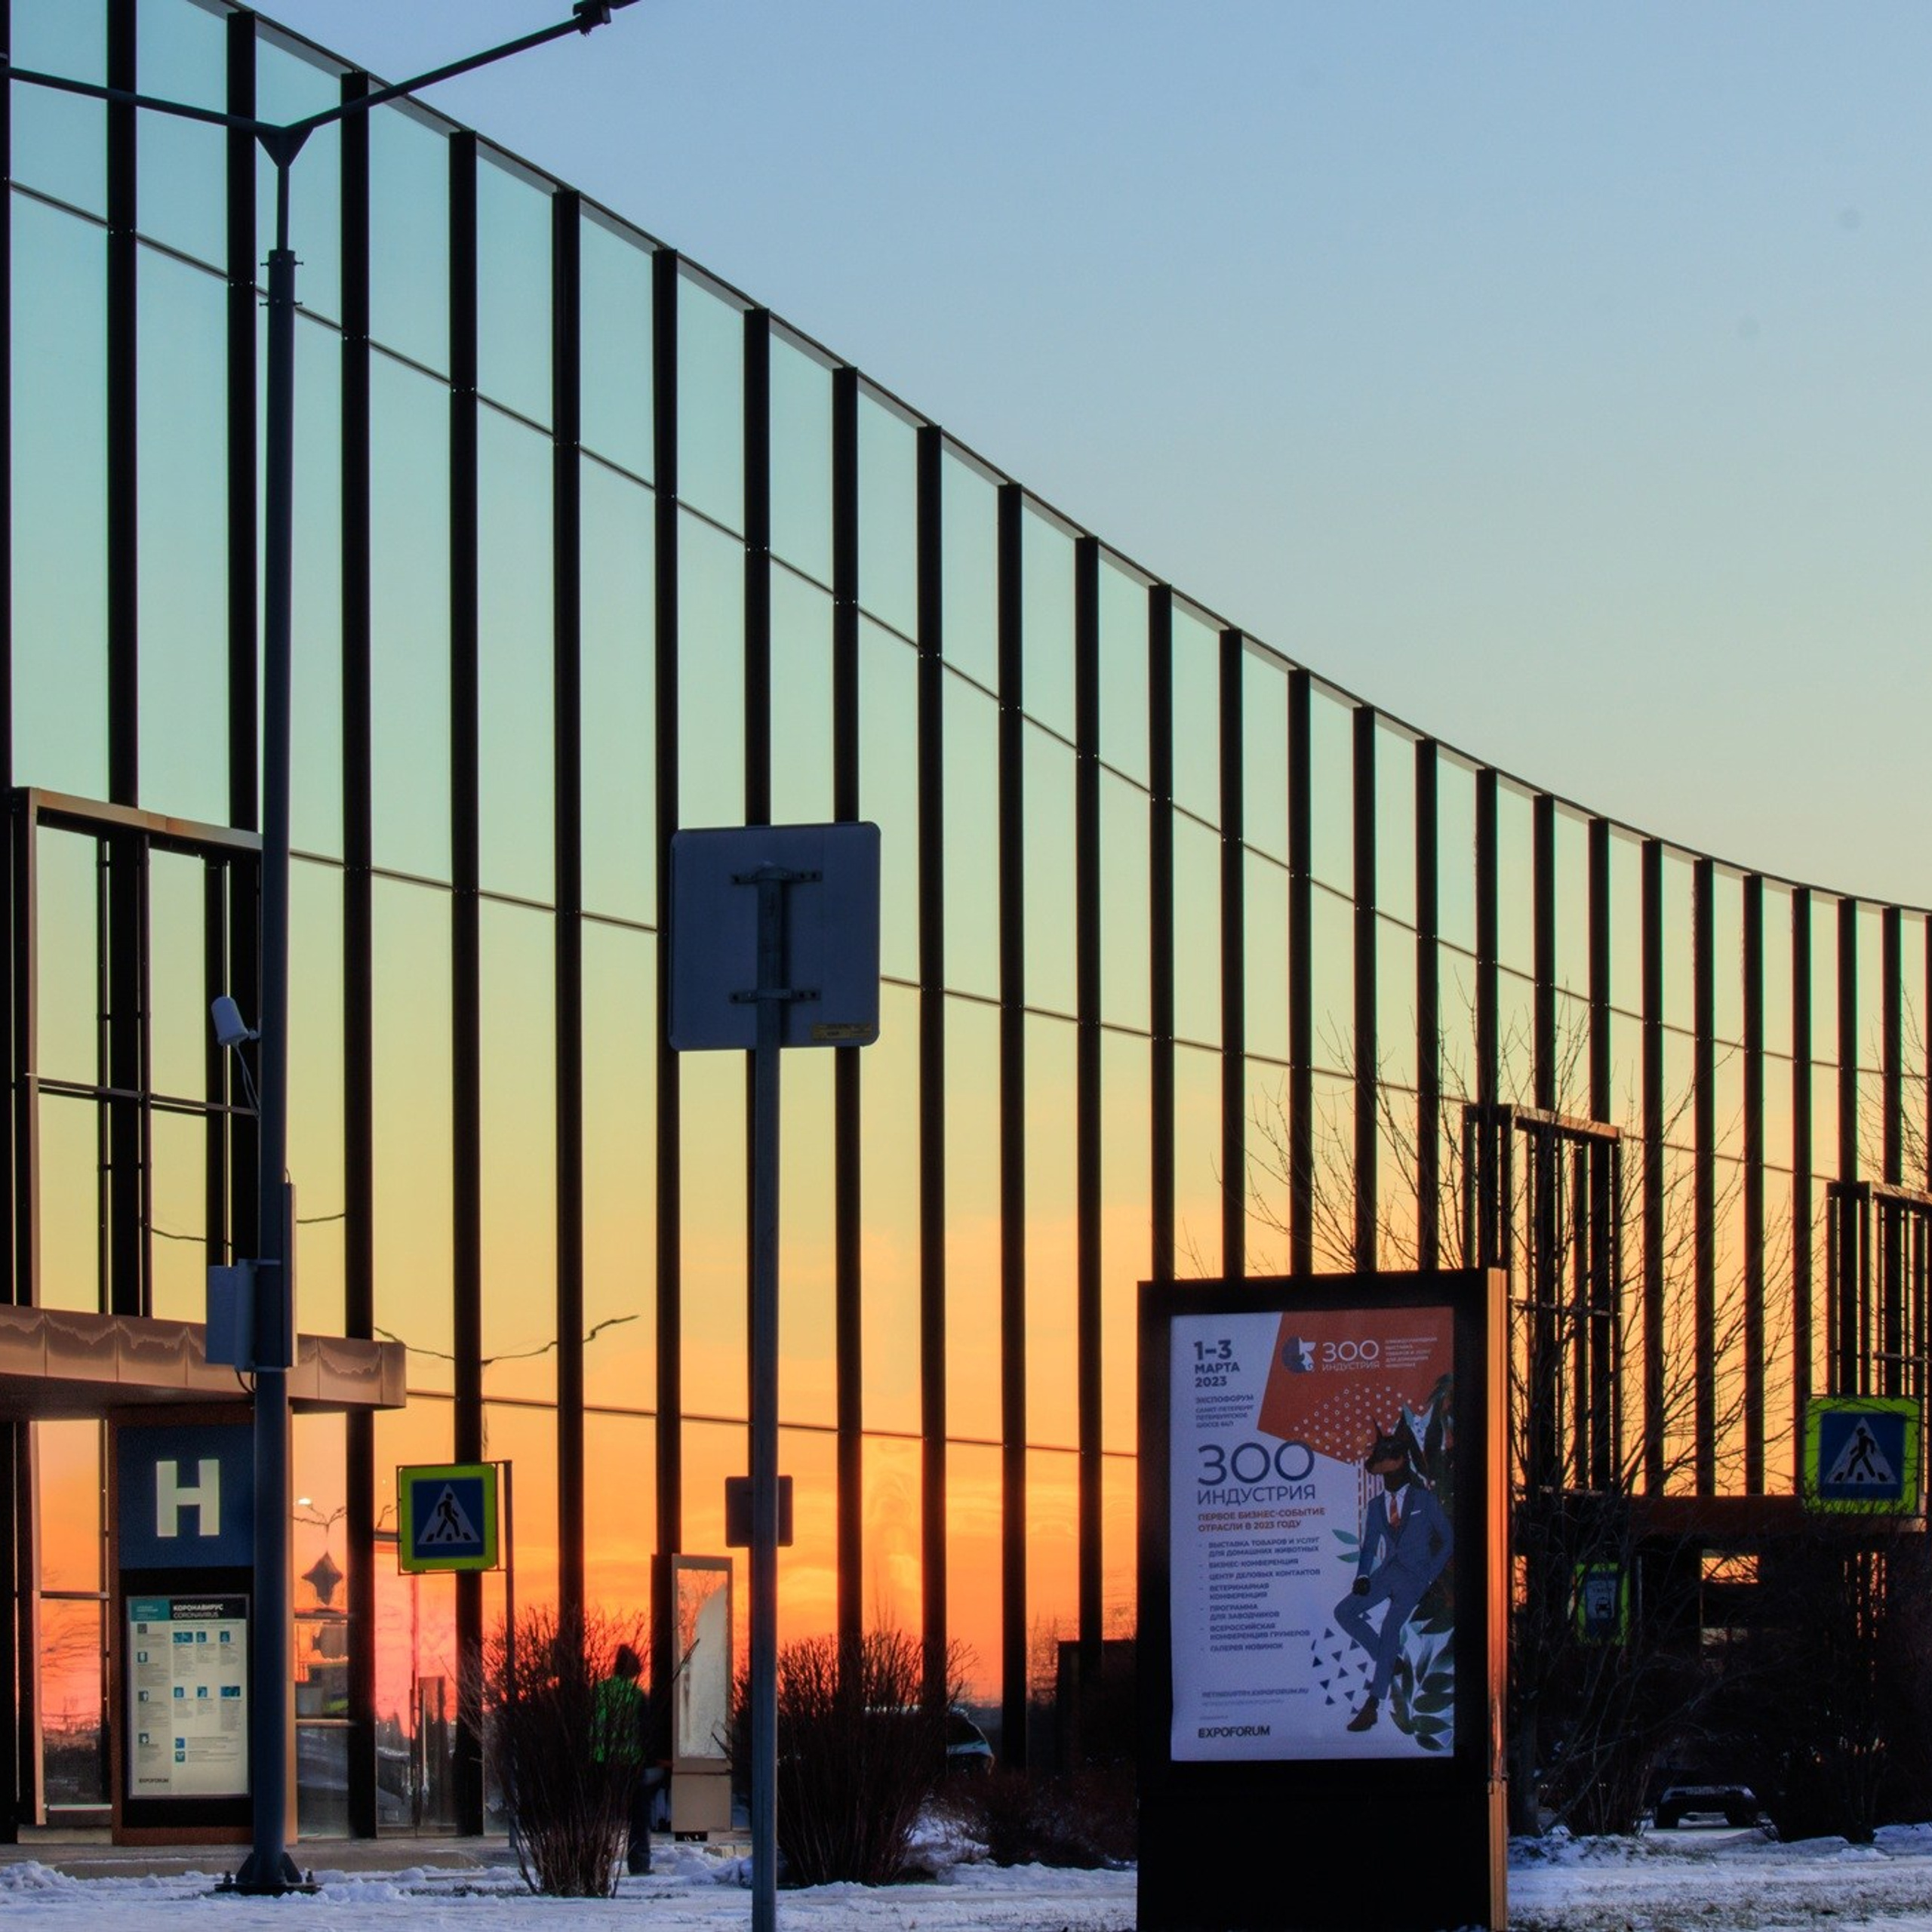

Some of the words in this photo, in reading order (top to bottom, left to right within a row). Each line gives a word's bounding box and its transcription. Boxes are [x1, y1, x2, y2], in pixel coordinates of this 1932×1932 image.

[1322, 1340, 1380, 1362] ЗОО
[1195, 1361, 1240, 1374] МАРТА
[1322, 1361, 1380, 1371] ИНДУСТРИЯ
[1195, 1376, 1227, 1388] 2023
[1198, 1441, 1315, 1486] ЗОО
[156, 1459, 220, 1537] H
[1198, 1484, 1315, 1506] ИНДУСТРИЯ
[1198, 1512, 1235, 1521] ПЕРВОЕ
[1238, 1508, 1324, 1519] БИЗНЕС-СОБЫТИЕ
[1198, 1522, 1243, 1532] ОТРАСЛИ
[1254, 1521, 1275, 1530] 2023
[1277, 1519, 1301, 1528] ГОДУ
[1209, 1540, 1249, 1549] ВЫСТАВКА
[1209, 1573, 1234, 1581] ЦЕНТР
[1275, 1568, 1320, 1577] КОНТАКТОВ
[1210, 1604, 1258, 1612] ПРОГРАММА
[1198, 1725, 1271, 1738] EXPOFORUM
